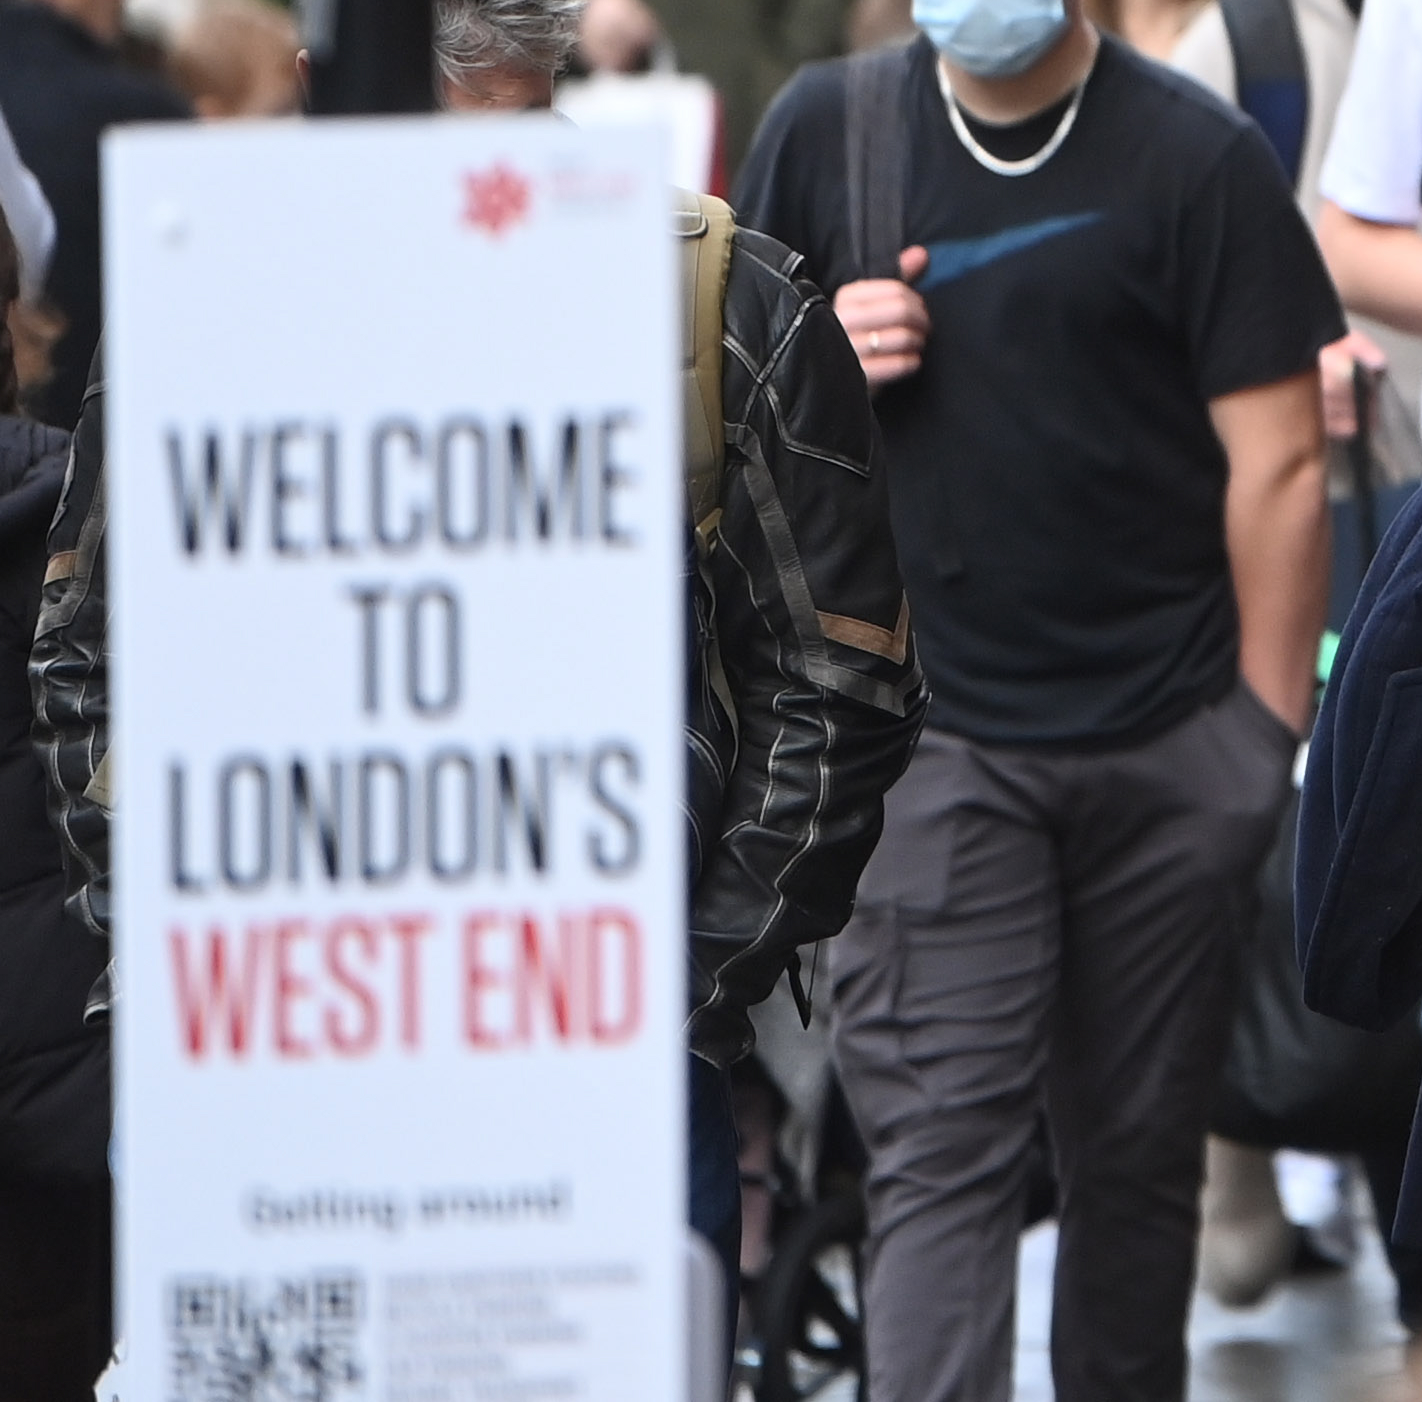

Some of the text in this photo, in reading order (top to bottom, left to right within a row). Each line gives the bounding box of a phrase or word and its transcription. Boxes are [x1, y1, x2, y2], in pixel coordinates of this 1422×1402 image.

[164, 411, 638, 558] WELCOME
[346, 582, 463, 719] TO
[167, 742, 643, 892] LONDON'S
[168, 907, 645, 1062] WEST END
[247, 1181, 570, 1232] Getting around
